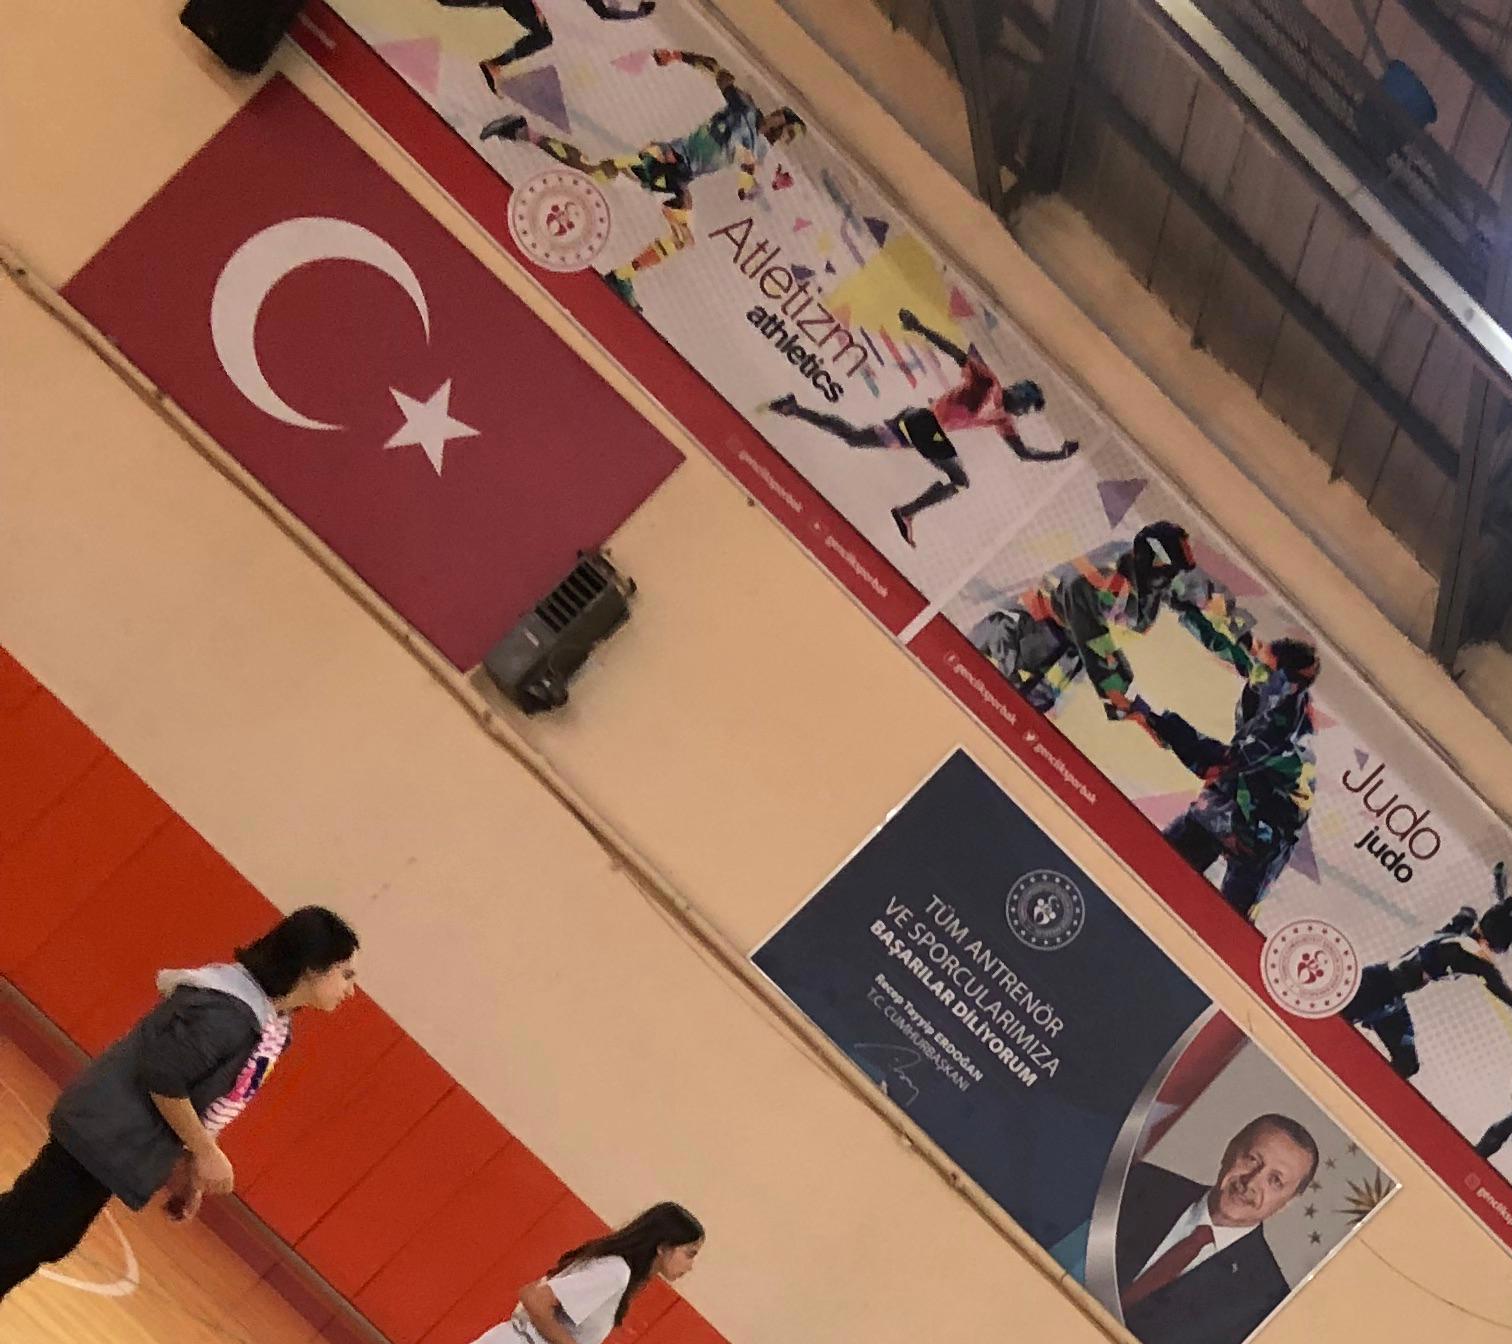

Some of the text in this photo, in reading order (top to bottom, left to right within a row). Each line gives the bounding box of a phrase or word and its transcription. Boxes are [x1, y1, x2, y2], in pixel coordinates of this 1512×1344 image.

[709, 215, 868, 379] Atletizm
[746, 304, 846, 404] athletics
[1341, 763, 1442, 863] Judo
[1355, 825, 1415, 885] judo
[870, 919, 955, 1006] BAŞARILAR
[952, 1001, 1038, 1087] DİLİYORUM
[875, 973, 904, 1004] Recep
[904, 1001, 935, 1035] Tayyip
[934, 1032, 983, 1081] ERDOĞAN
[886, 896, 914, 928] VE
[908, 922, 1060, 1078] SPORCULARIMIZA
[925, 894, 969, 944] TÜM
[964, 940, 1064, 1038] ANTRENÖR
